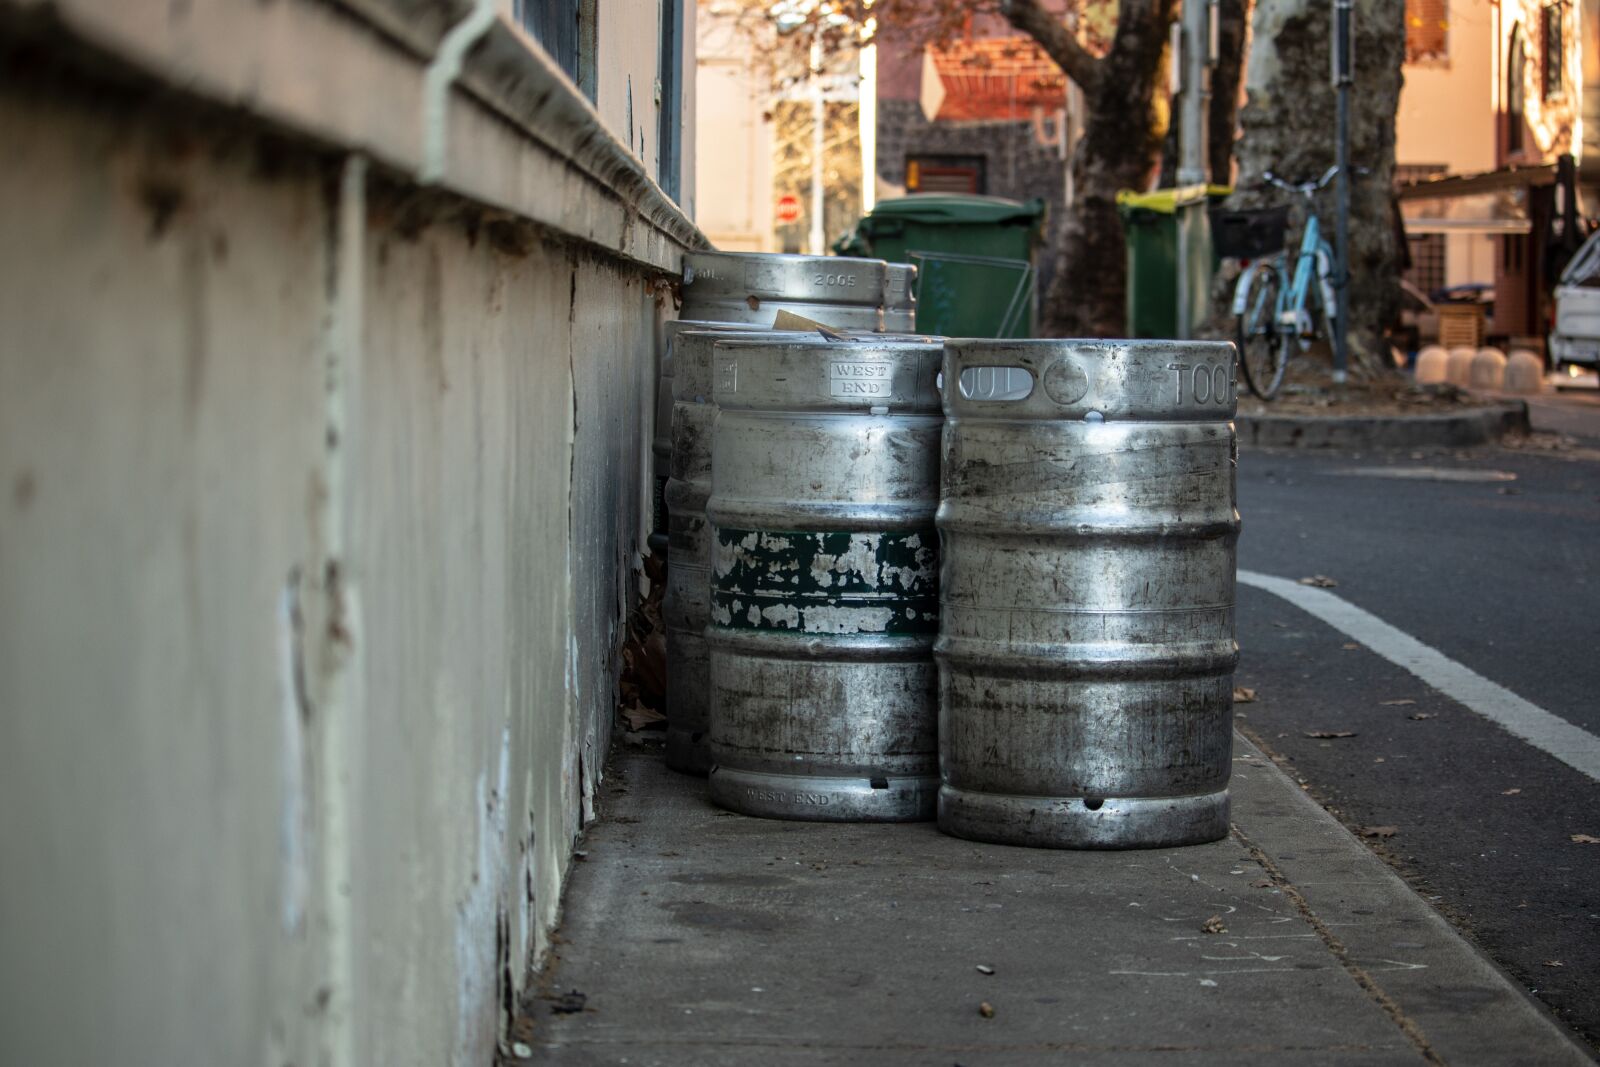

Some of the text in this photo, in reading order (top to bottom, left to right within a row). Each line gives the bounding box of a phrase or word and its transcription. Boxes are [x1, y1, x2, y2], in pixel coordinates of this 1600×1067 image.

[814, 273, 857, 288] 2005
[836, 364, 887, 377] WEST
[842, 382, 880, 394] END
[746, 787, 830, 805] WEST END
